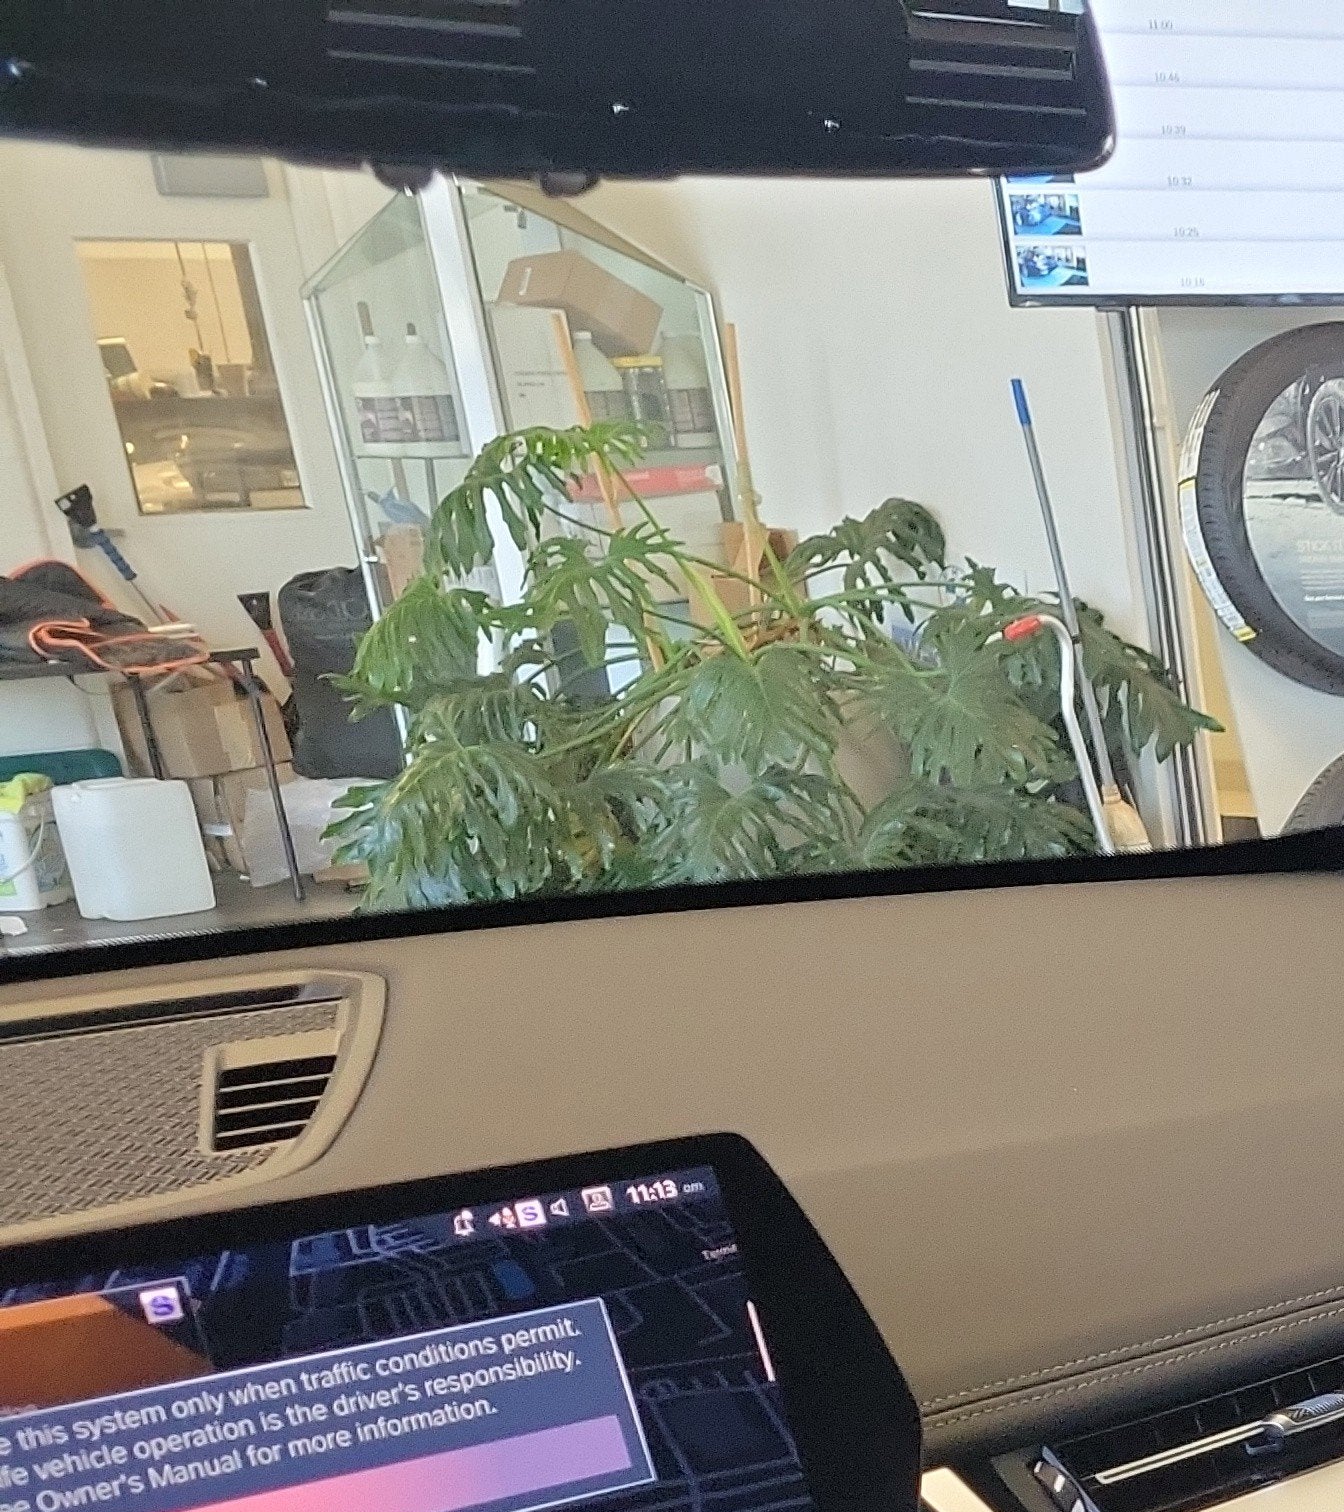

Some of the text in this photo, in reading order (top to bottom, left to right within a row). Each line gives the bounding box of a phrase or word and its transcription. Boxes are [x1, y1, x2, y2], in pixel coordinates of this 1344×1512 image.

[625, 1179, 678, 1205] 11:13
[14, 1422, 69, 1452] this
[70, 1403, 168, 1443] system
[168, 1390, 227, 1424] only
[226, 1376, 298, 1408] when
[298, 1360, 372, 1391] traffic
[372, 1334, 498, 1376] conditions
[499, 1318, 583, 1353] permit.
[30, 1441, 130, 1483] vehicle
[130, 1415, 257, 1463] operation
[258, 1411, 284, 1431] is
[284, 1401, 331, 1425] the
[330, 1381, 421, 1415] driver's
[422, 1348, 583, 1400] responsibility.
[146, 1449, 244, 1489] Manual
[243, 1440, 284, 1466] for
[287, 1430, 353, 1456] more
[354, 1396, 499, 1442] information.
